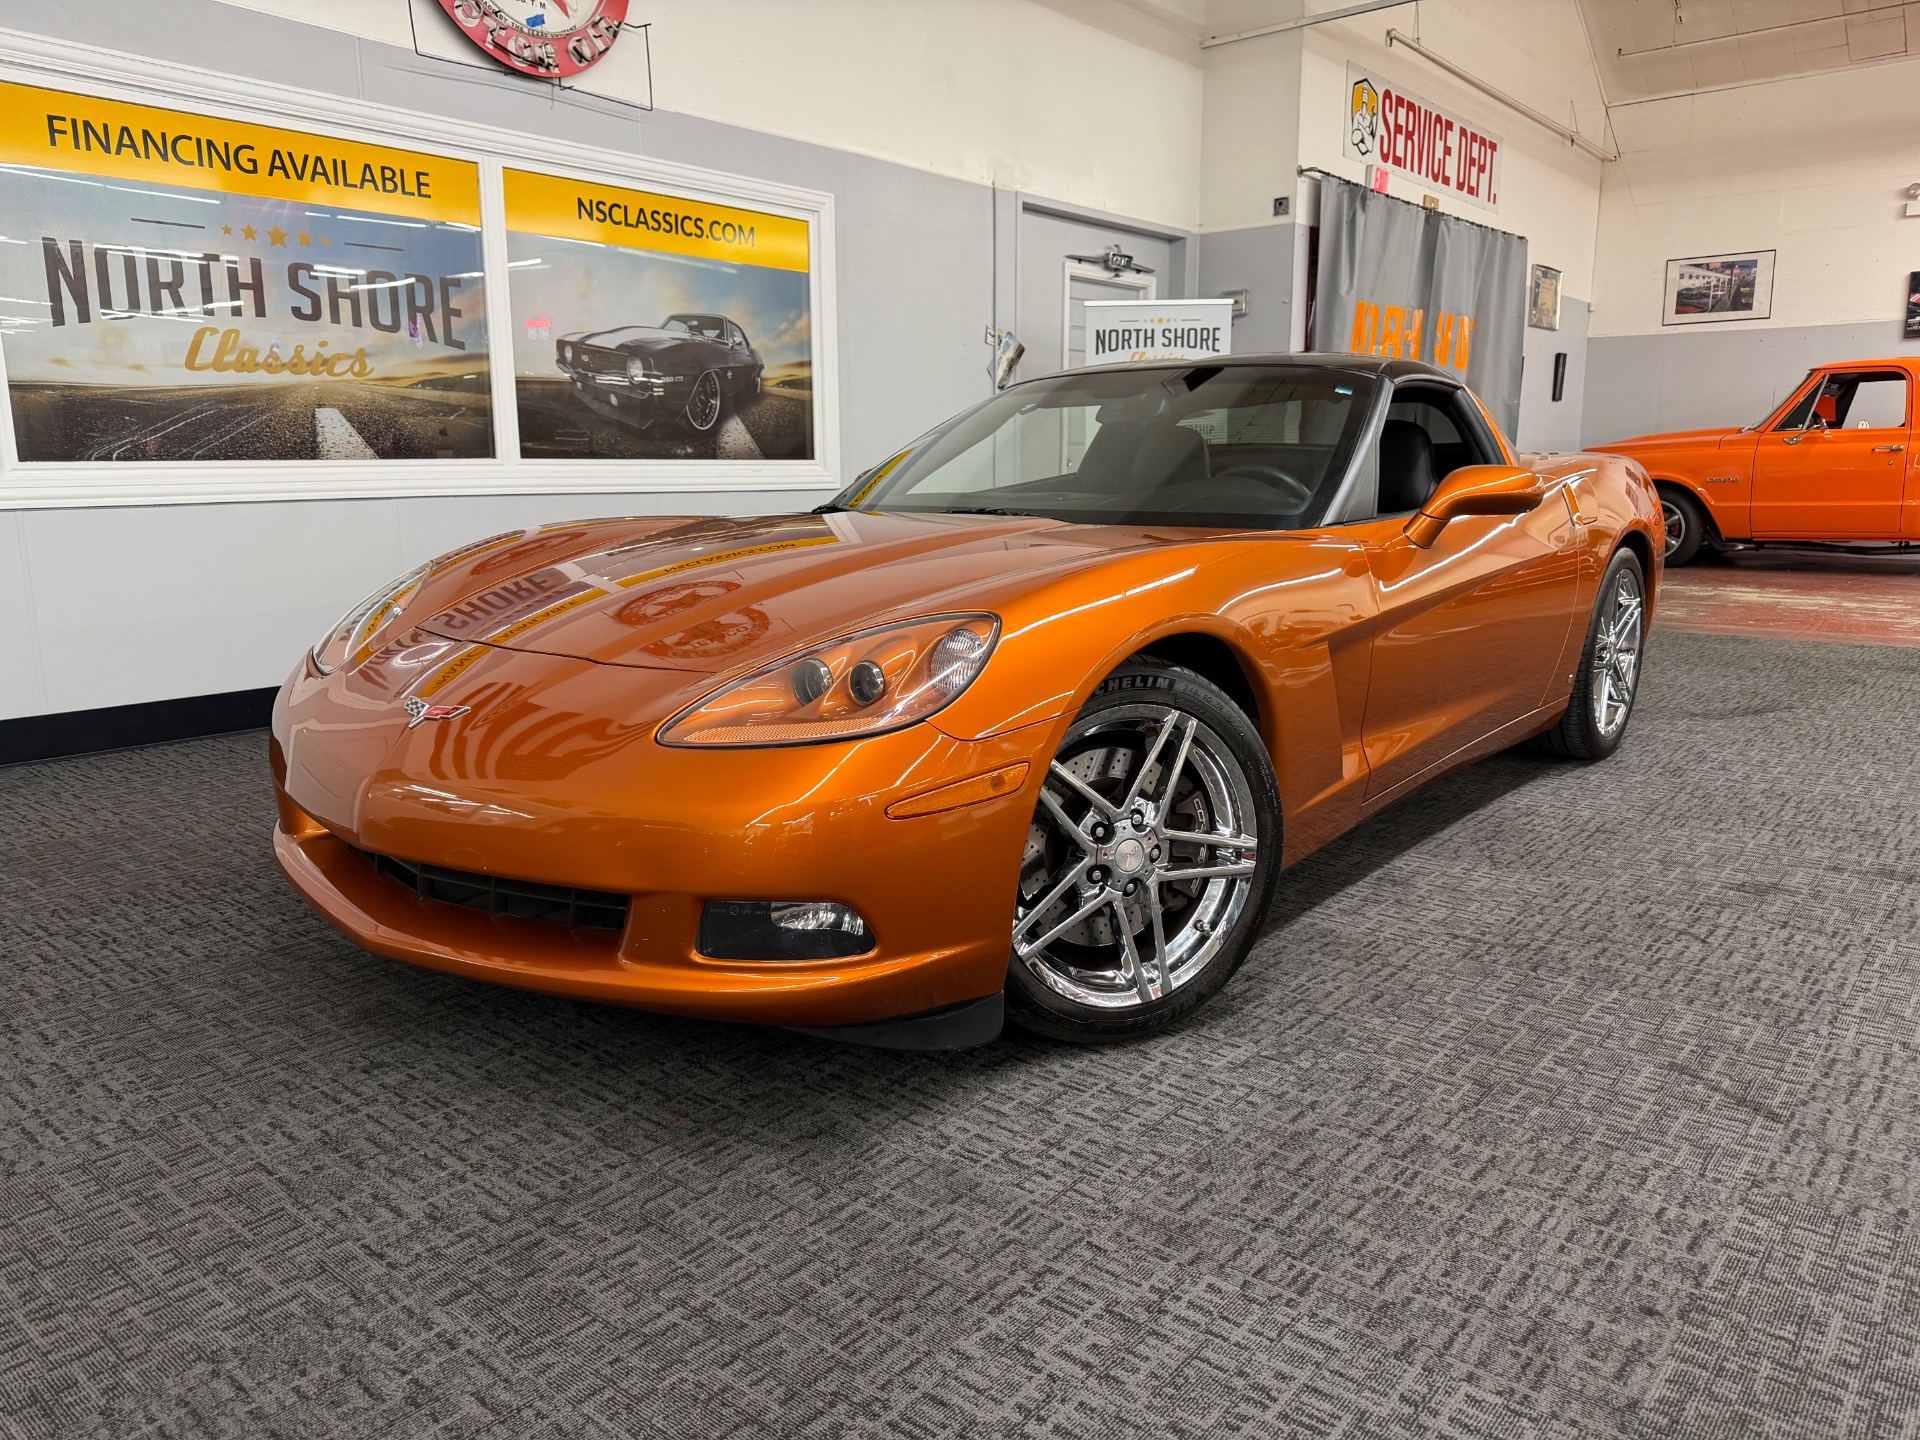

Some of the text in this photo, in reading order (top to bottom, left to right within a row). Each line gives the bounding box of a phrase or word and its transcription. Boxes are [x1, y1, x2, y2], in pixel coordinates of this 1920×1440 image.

[511, 22, 524, 33] THE
[527, 28, 548, 38] TEXAS
[46, 114, 432, 199] FINANCING AVAILABLE
[1379, 88, 1498, 205] SERVICE DEPT.
[577, 197, 756, 247] NSCLASSICS.COM
[41, 236, 466, 351] NORTH SHORE
[185, 326, 374, 378] Classics
[1095, 327, 1221, 356] NORTH SHORE
[1094, 675, 1170, 696] CHELIN
